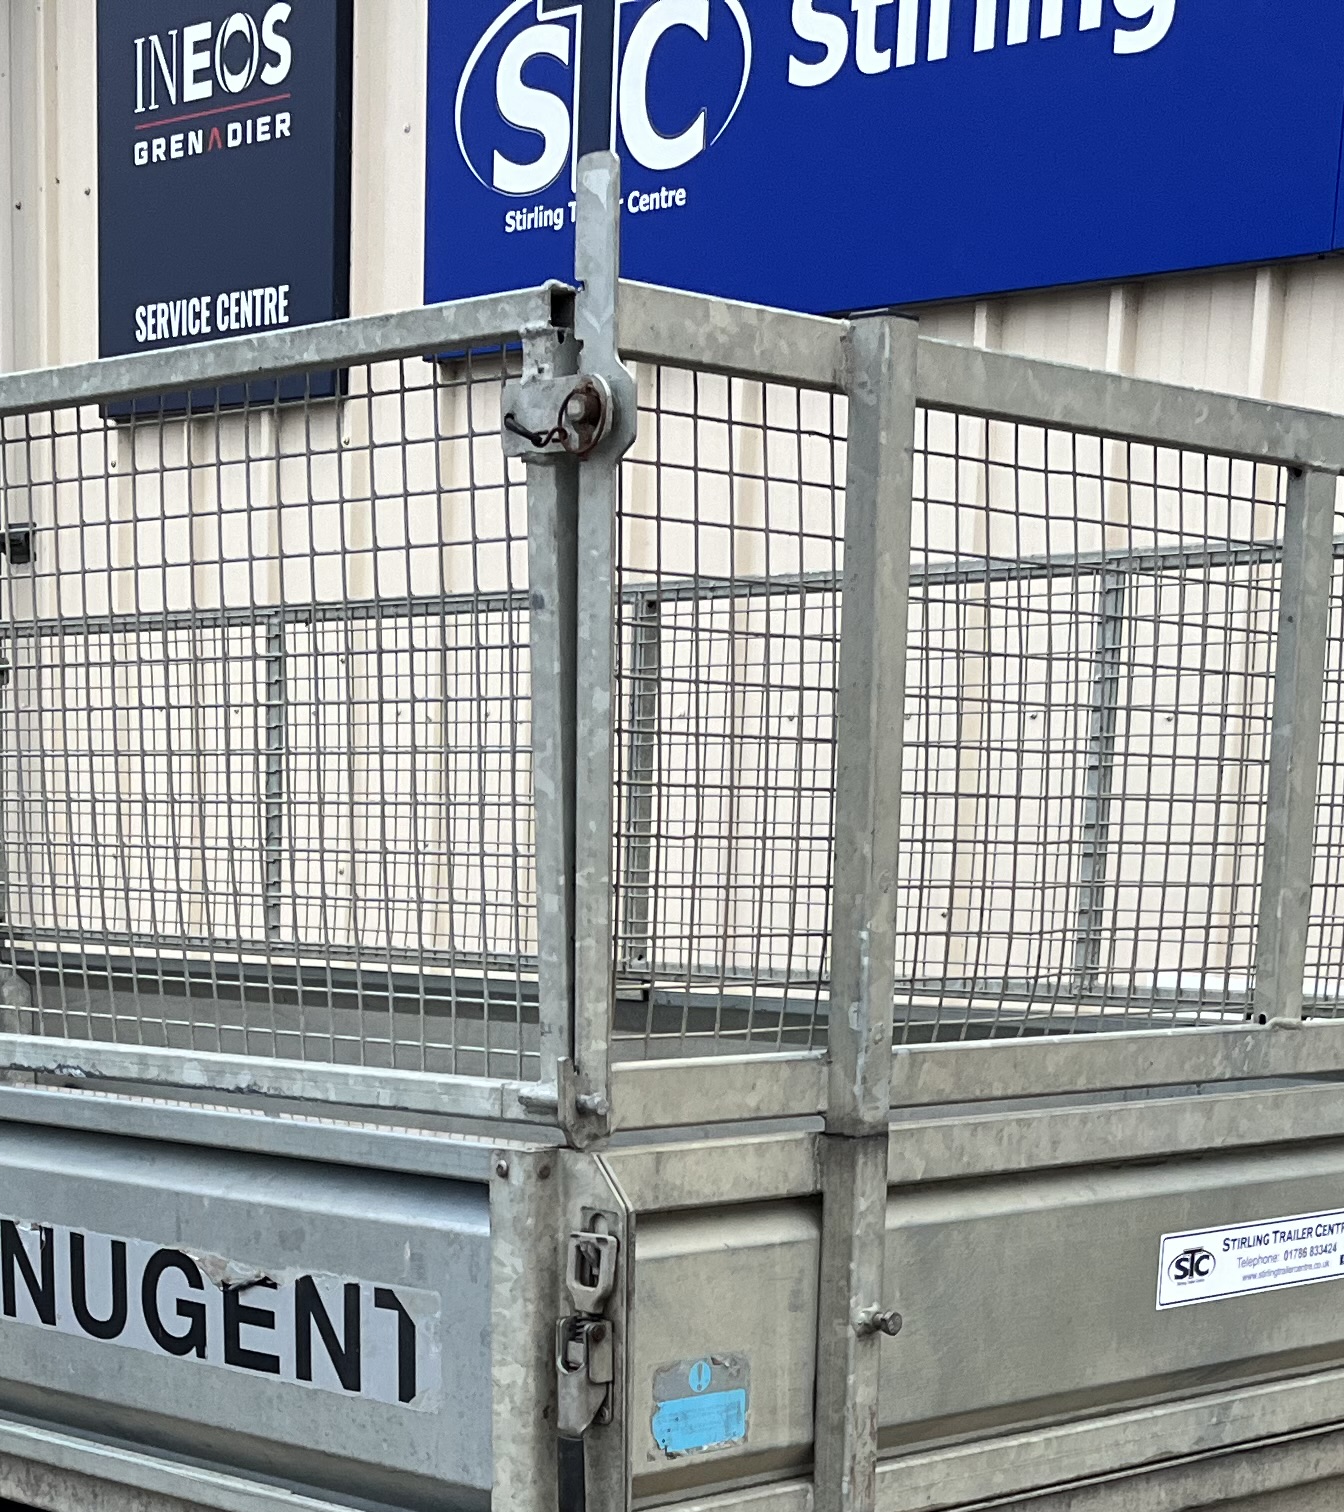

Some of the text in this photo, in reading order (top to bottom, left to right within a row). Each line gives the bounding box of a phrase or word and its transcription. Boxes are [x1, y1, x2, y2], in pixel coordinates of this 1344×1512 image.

[133, 2, 292, 113] INEOS
[133, 111, 291, 166] GRENADIER
[505, 204, 564, 233] Stirling
[627, 186, 687, 213] Centre
[135, 284, 290, 343] SERVICE CENTRE
[1174, 1247, 1210, 1280] STC
